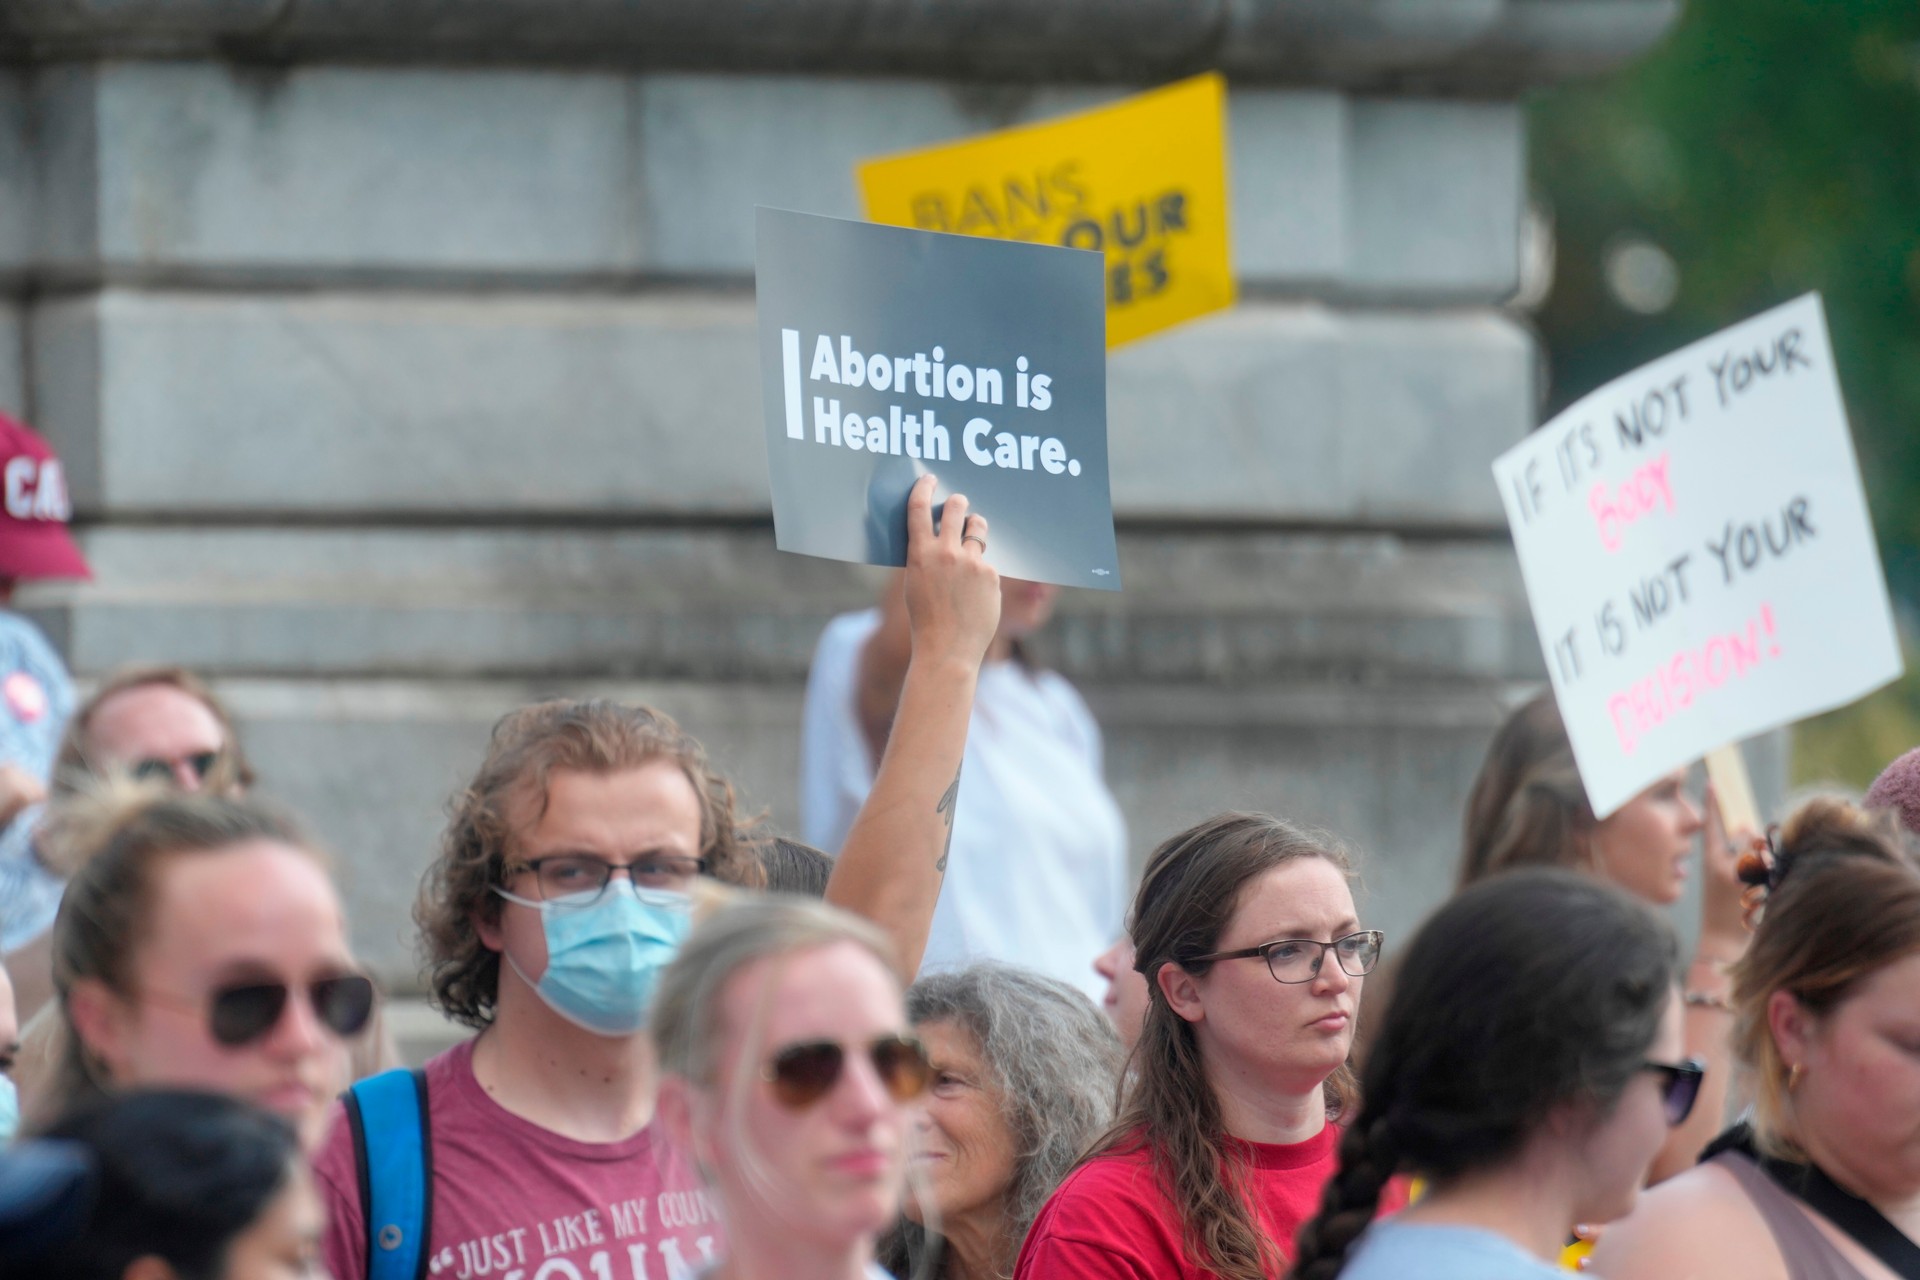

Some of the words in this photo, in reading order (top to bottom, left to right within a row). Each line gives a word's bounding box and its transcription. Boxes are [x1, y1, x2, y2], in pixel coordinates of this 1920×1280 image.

[1064, 188, 1191, 252] OUR
[1107, 248, 1170, 305] ES
[810, 334, 1003, 405] Abortion
[1016, 355, 1053, 411] is
[813, 396, 950, 461] Health
[962, 417, 1081, 476] Care.
[1511, 456, 1542, 525] IF
[1613, 374, 1689, 450] NOT
[1706, 327, 1811, 408] YOUR
[1588, 449, 1675, 552] BODY
[1553, 624, 1583, 686] IT
[1595, 600, 1624, 656] IS
[1628, 555, 1690, 629] NOT
[1706, 496, 1818, 585] YOUR
[1606, 601, 1782, 755] DECISION!
[537, 1207, 605, 1257] LIKE
[609, 1197, 648, 1240] MY
[656, 1189, 721, 1229] COUN
